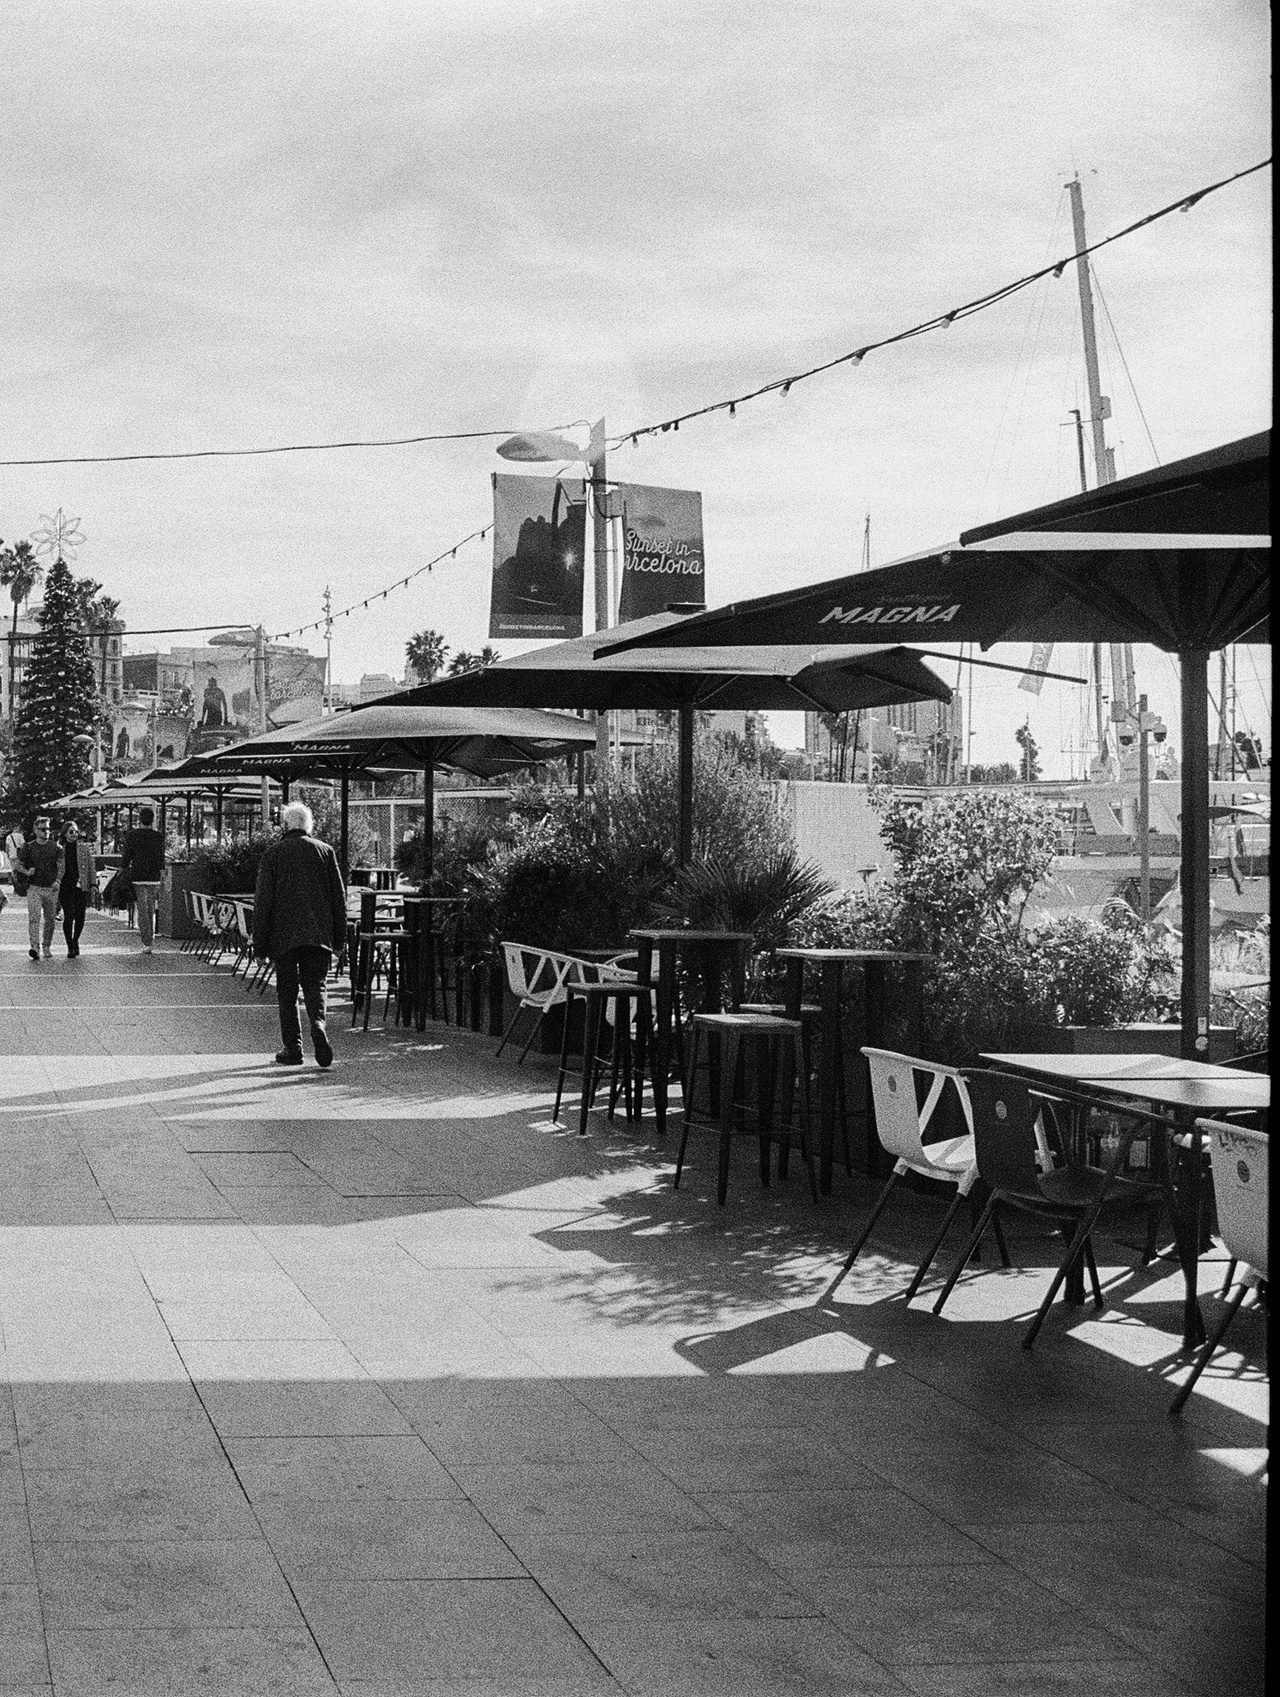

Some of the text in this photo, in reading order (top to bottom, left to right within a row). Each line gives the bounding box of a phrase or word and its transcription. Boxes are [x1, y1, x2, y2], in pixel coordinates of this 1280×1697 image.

[625, 530, 673, 555] Sunset
[625, 552, 703, 575] rcelona
[818, 604, 961, 624] MAGNA
[293, 744, 351, 752] MAGNA
